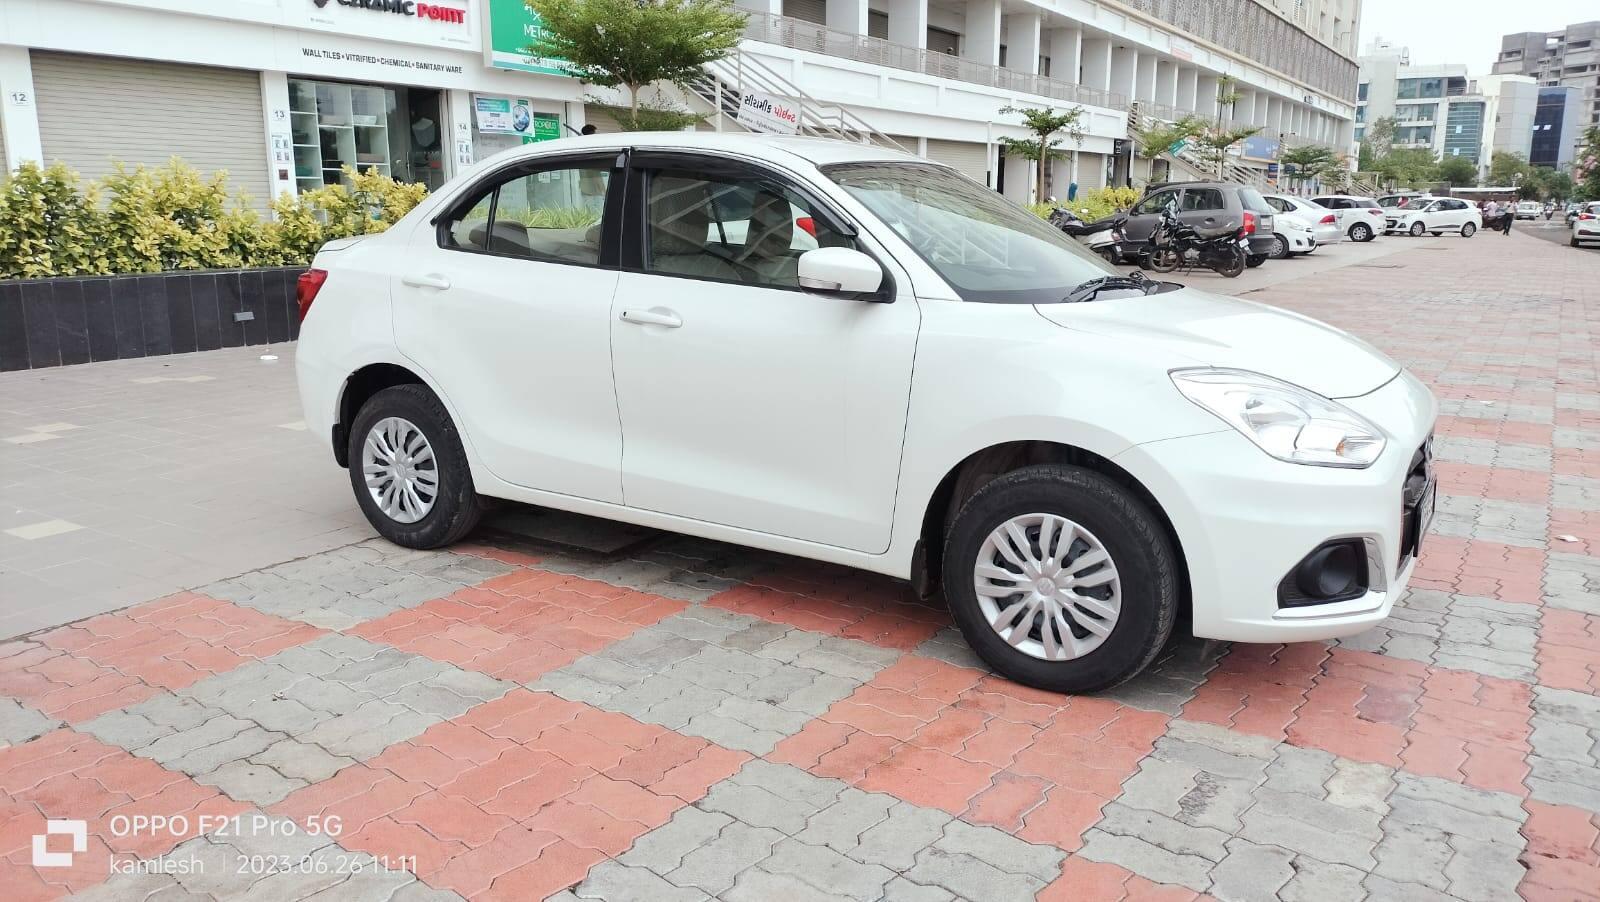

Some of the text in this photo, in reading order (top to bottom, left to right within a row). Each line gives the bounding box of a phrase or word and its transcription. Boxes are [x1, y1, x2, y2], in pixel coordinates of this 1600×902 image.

[417, 3, 465, 24] POINT
[302, 48, 462, 74] WALL TILES VITRIFIED CHEMICAL SANITARY WARE
[12, 93, 27, 102] 12
[274, 110, 285, 118] 13
[459, 123, 467, 131] 14
